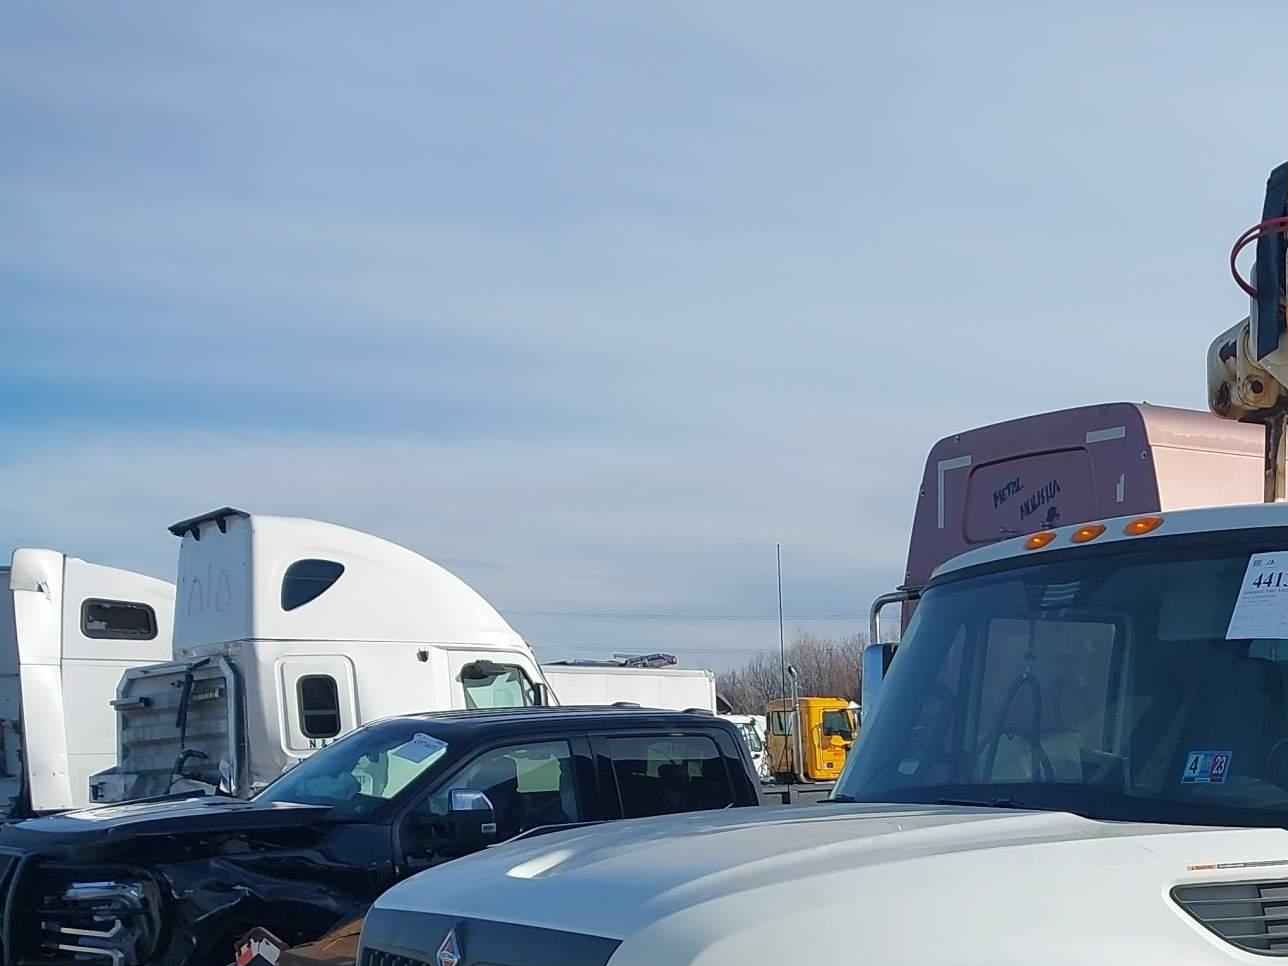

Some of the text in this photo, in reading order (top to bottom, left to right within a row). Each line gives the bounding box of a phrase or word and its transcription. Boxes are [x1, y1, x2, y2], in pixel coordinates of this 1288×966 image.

[993, 477, 1024, 509] METAL
[309, 740, 317, 748] N
[1190, 755, 1227, 774] 4 23
